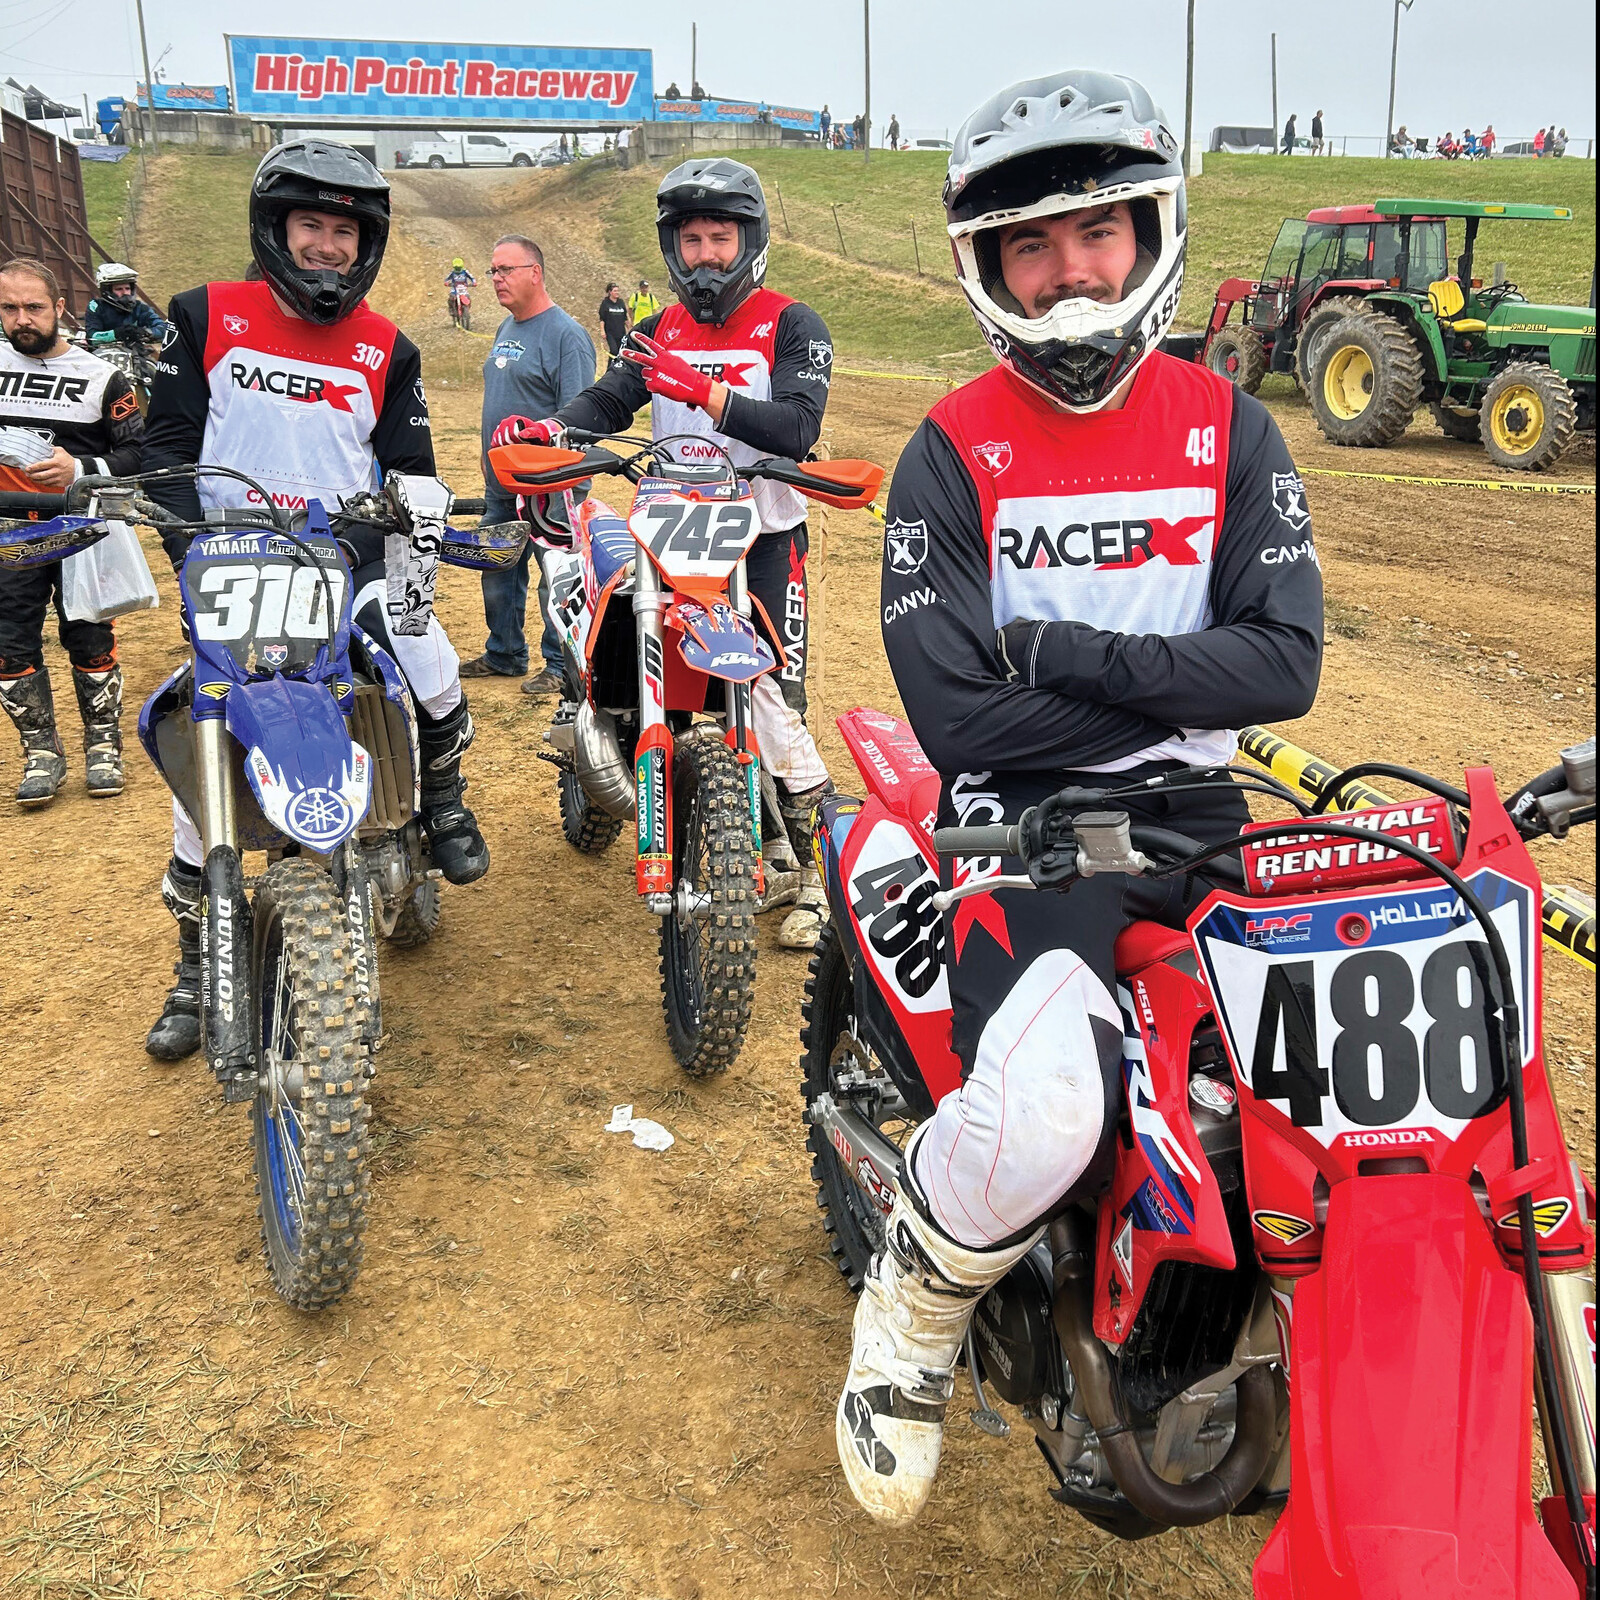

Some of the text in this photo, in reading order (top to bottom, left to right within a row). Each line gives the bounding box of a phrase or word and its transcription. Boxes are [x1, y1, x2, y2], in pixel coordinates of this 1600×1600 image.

[254, 54, 636, 106] High Point Raceway
[1510, 323, 1526, 331] JOHN
[352, 342, 386, 371] 310
[657, 372, 679, 387] THOR
[0, 371, 90, 403] MSR
[231, 363, 363, 414] RACERX
[1185, 425, 1216, 468] 48
[640, 482, 682, 491] WILLIAMSON
[200, 540, 260, 556] YAMAHA
[645, 504, 753, 562] 742
[999, 514, 1216, 571] RACERX
[195, 564, 346, 641] 310
[781, 536, 808, 683] RACERX
[710, 652, 760, 668] KTM
[860, 738, 900, 785] DUNLOP
[639, 783, 648, 841] MOTOREX
[651, 771, 664, 849] DUNLOP
[852, 852, 947, 999] 488
[217, 894, 233, 1022] DUNLOP
[1251, 940, 1510, 1127] 488
[1343, 1130, 1435, 1148] HONDA
